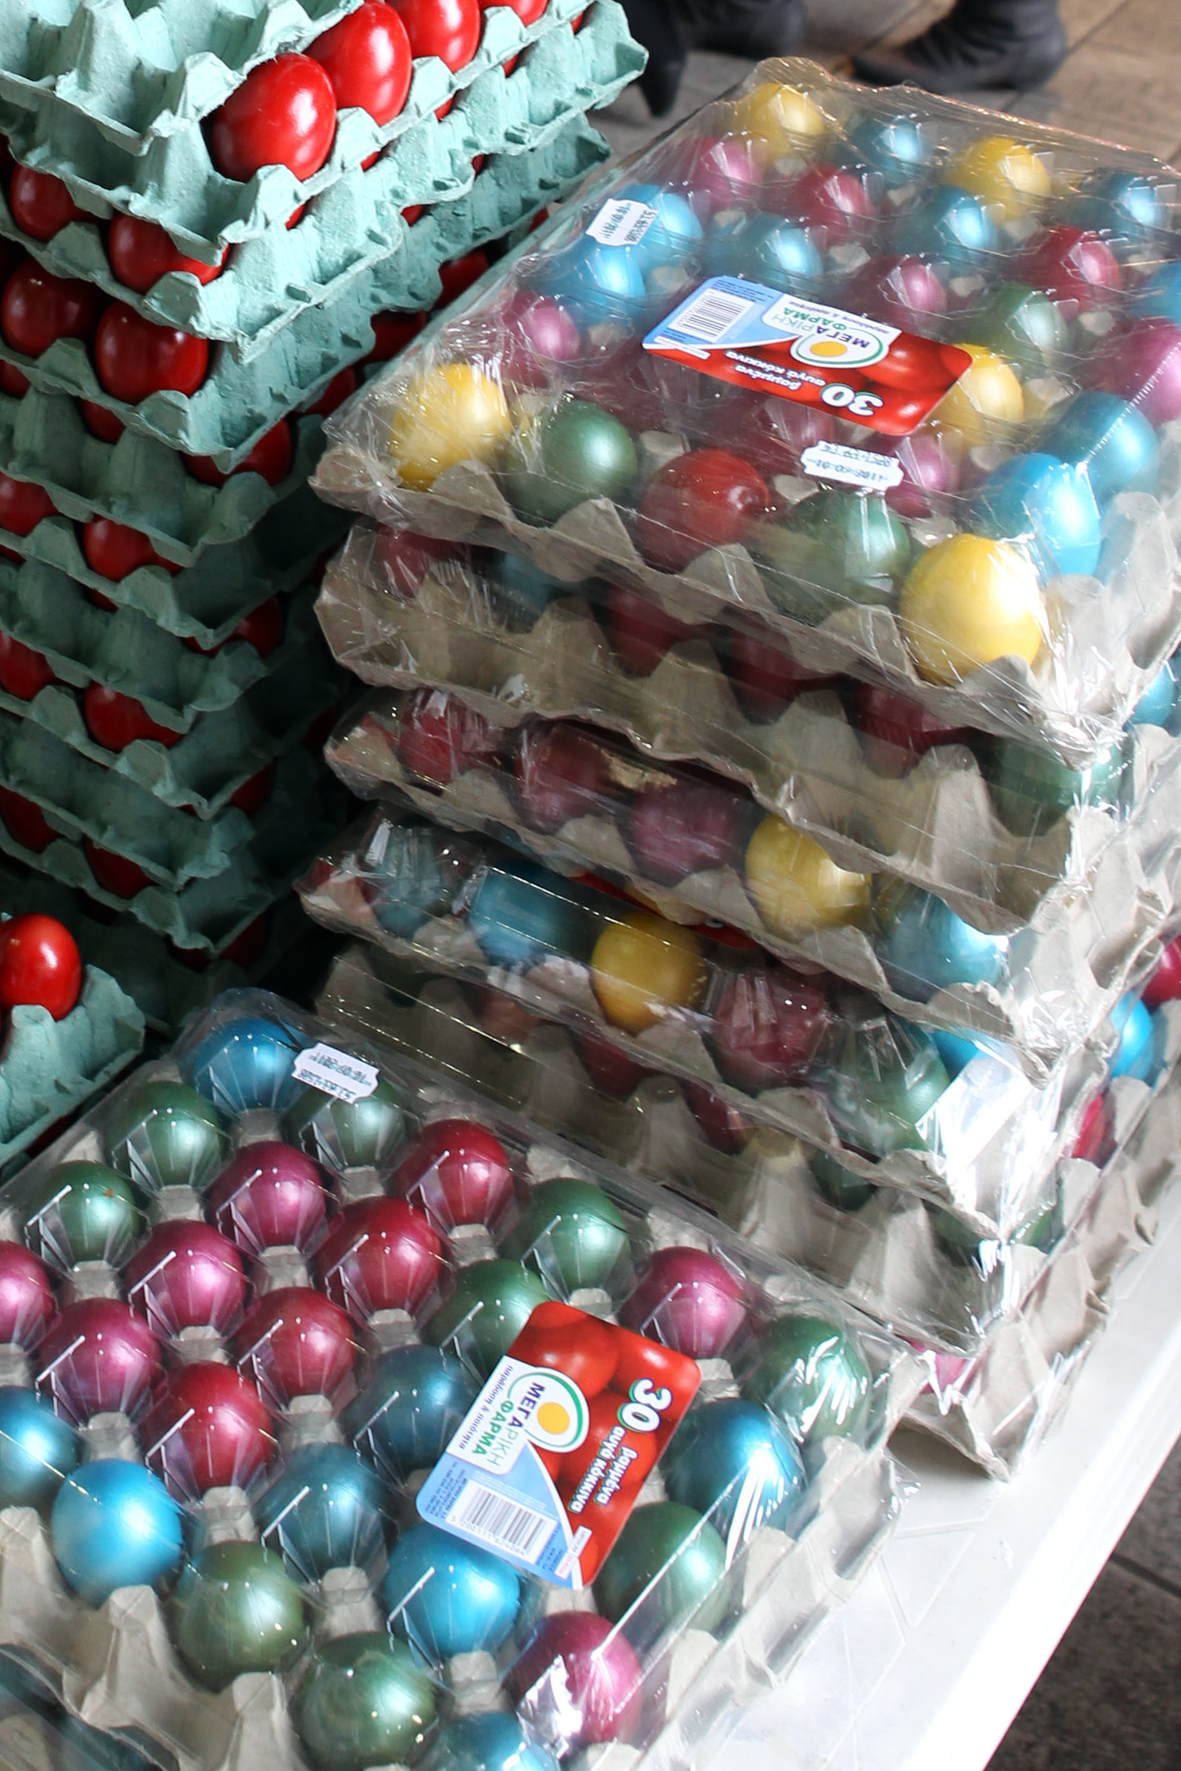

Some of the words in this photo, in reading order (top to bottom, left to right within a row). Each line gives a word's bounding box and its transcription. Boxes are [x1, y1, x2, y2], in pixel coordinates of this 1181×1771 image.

[772, 311, 871, 350] ΜΕΓΑΡΙΚΗ
[782, 306, 848, 331] ΦΑΡΜΑ
[724, 349, 785, 374] κόκκινα
[733, 363, 802, 391] βαμμένα
[785, 368, 827, 387] αυγά
[820, 381, 884, 417] 30
[618, 1377, 672, 1433] 30
[472, 1400, 514, 1457] ΦΑΡΜΑ
[486, 1381, 546, 1467] ΜΕΓΑΡΙΚΗ
[599, 1425, 626, 1459] αυγά
[568, 1454, 609, 1515] κόκκινα
[596, 1445, 638, 1507] βαμμένα
